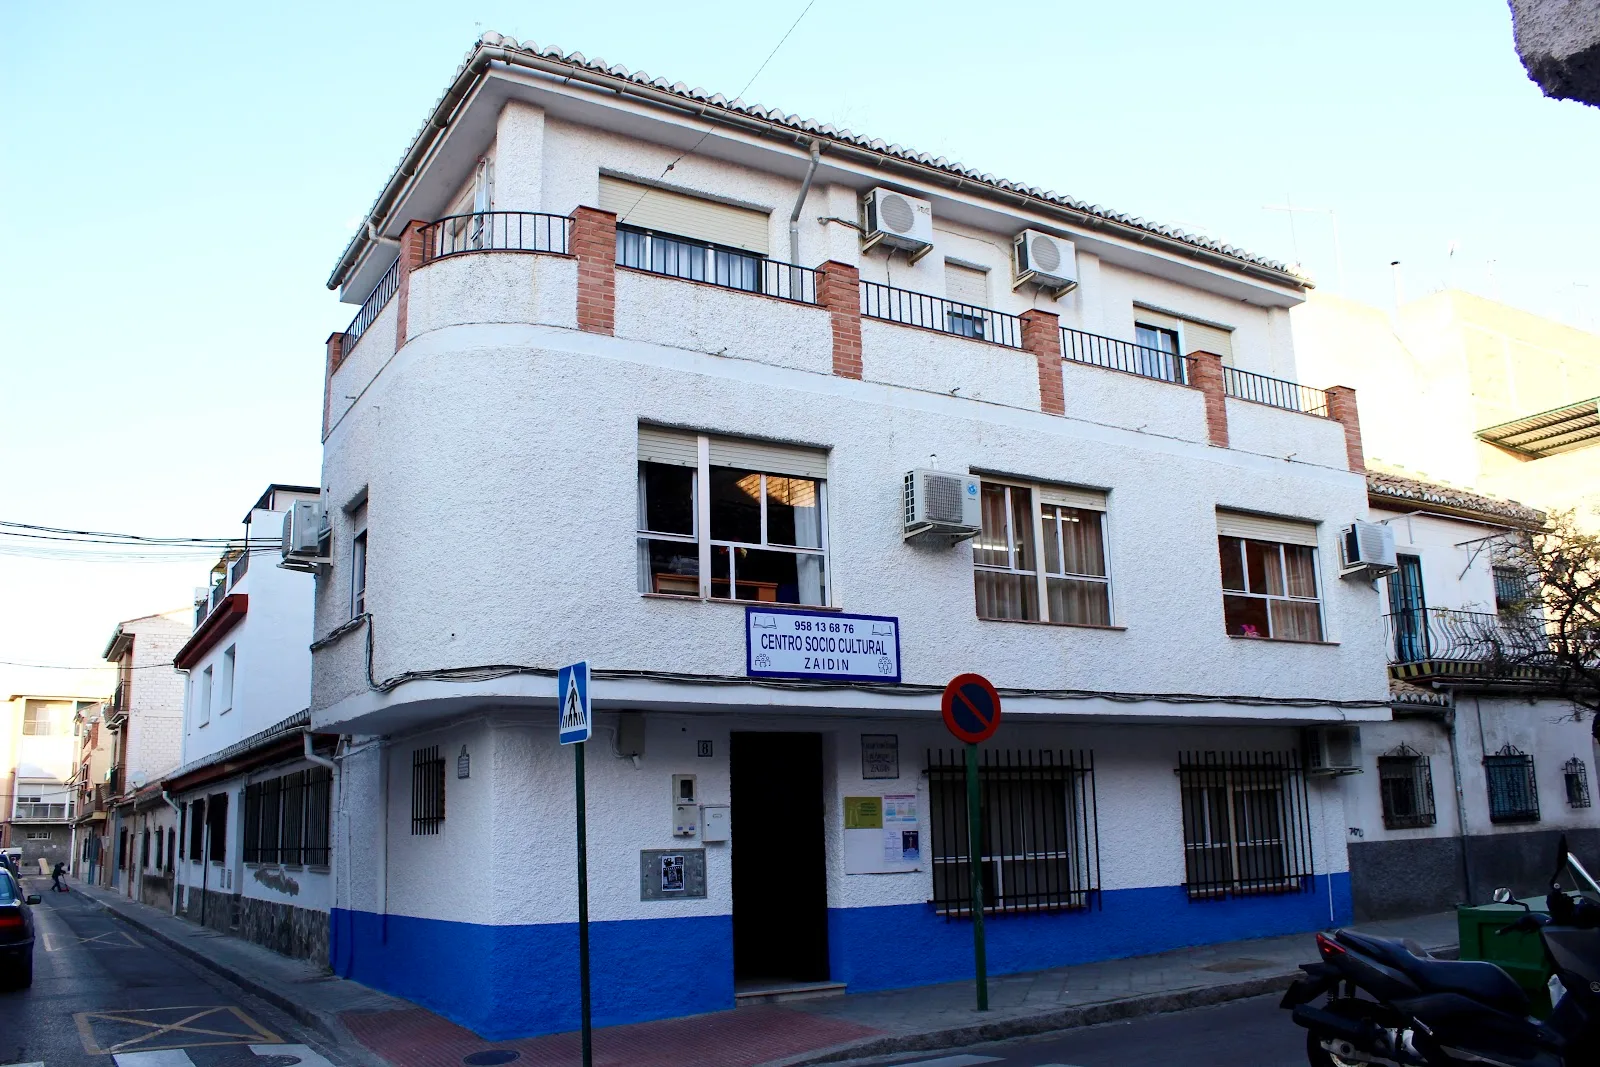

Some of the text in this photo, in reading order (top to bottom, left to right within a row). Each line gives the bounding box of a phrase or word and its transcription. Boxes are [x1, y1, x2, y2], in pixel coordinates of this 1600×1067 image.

[795, 621, 854, 634] 958 13 68 76
[761, 634, 887, 655] CENTRO SOCIO CULTURAL
[805, 658, 849, 670] ZAIDIN
[702, 742, 709, 755] 8
